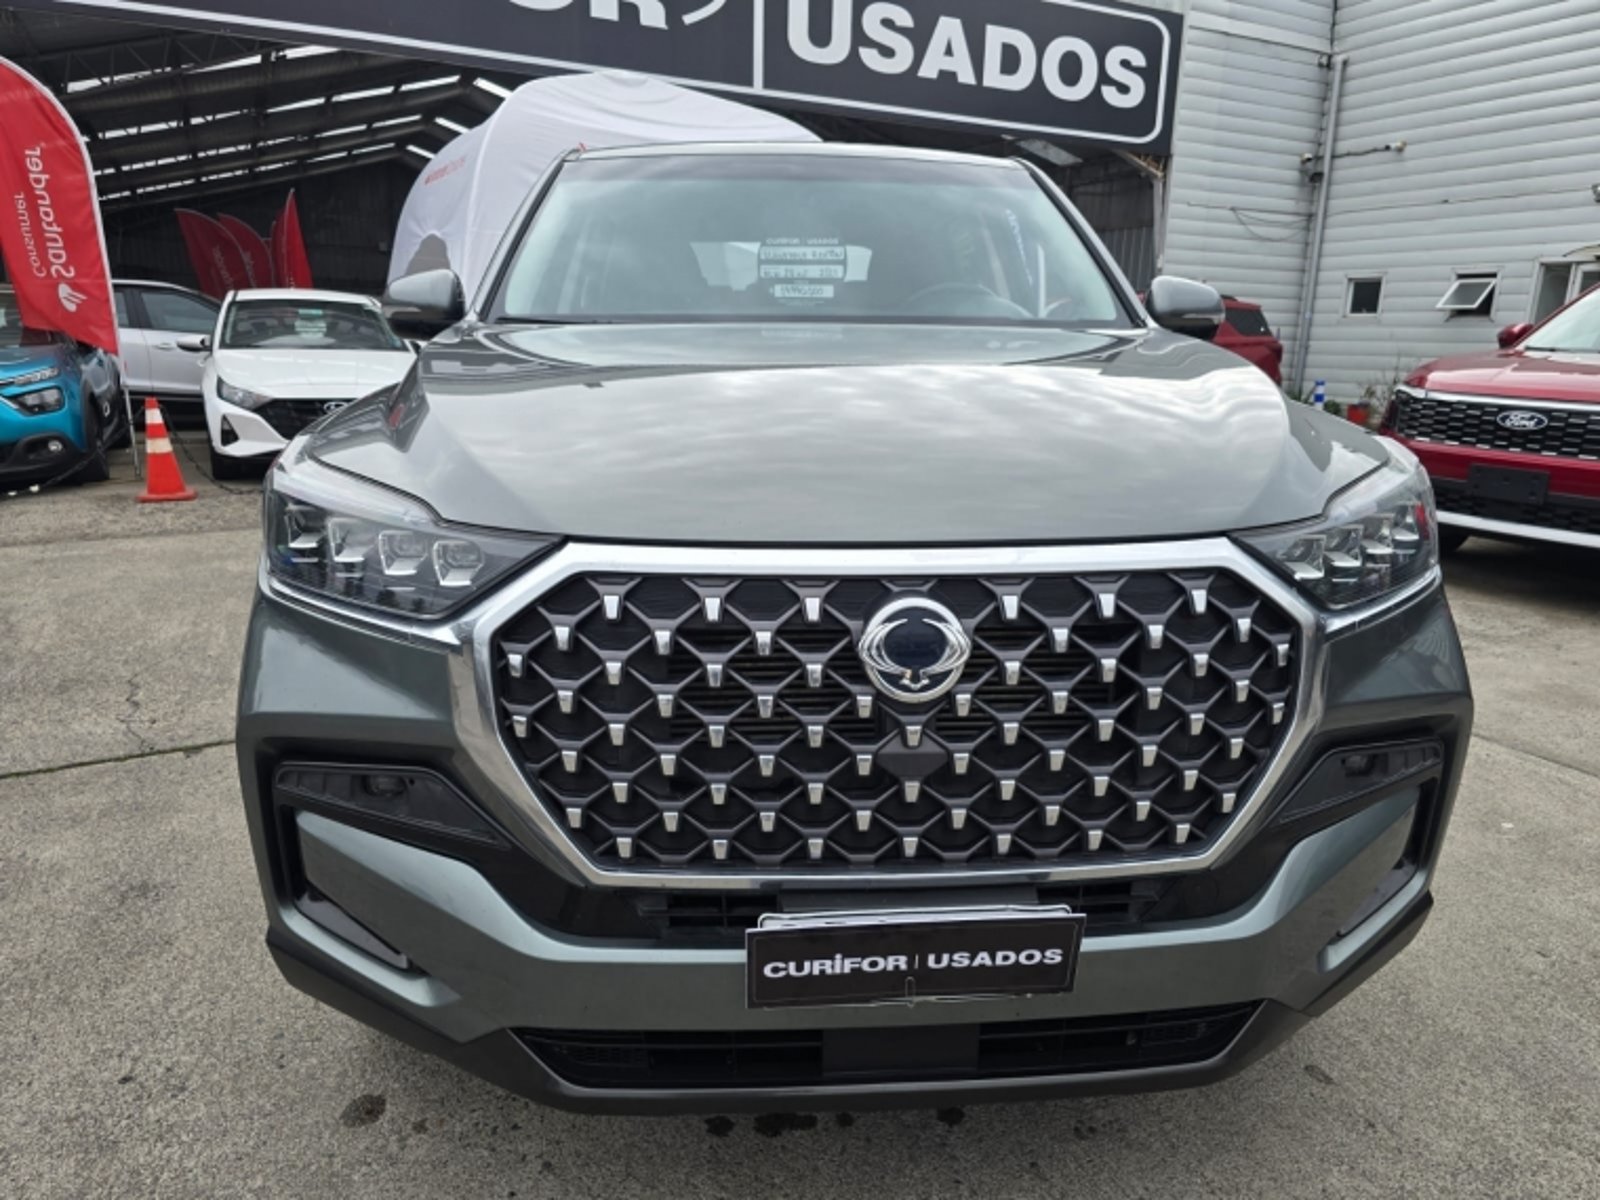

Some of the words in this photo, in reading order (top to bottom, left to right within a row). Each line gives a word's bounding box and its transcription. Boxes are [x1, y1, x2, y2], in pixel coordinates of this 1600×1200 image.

[787, 0, 1147, 108] USADOS
[1504, 411, 1538, 428] Ford
[927, 949, 1063, 969] USADOS
